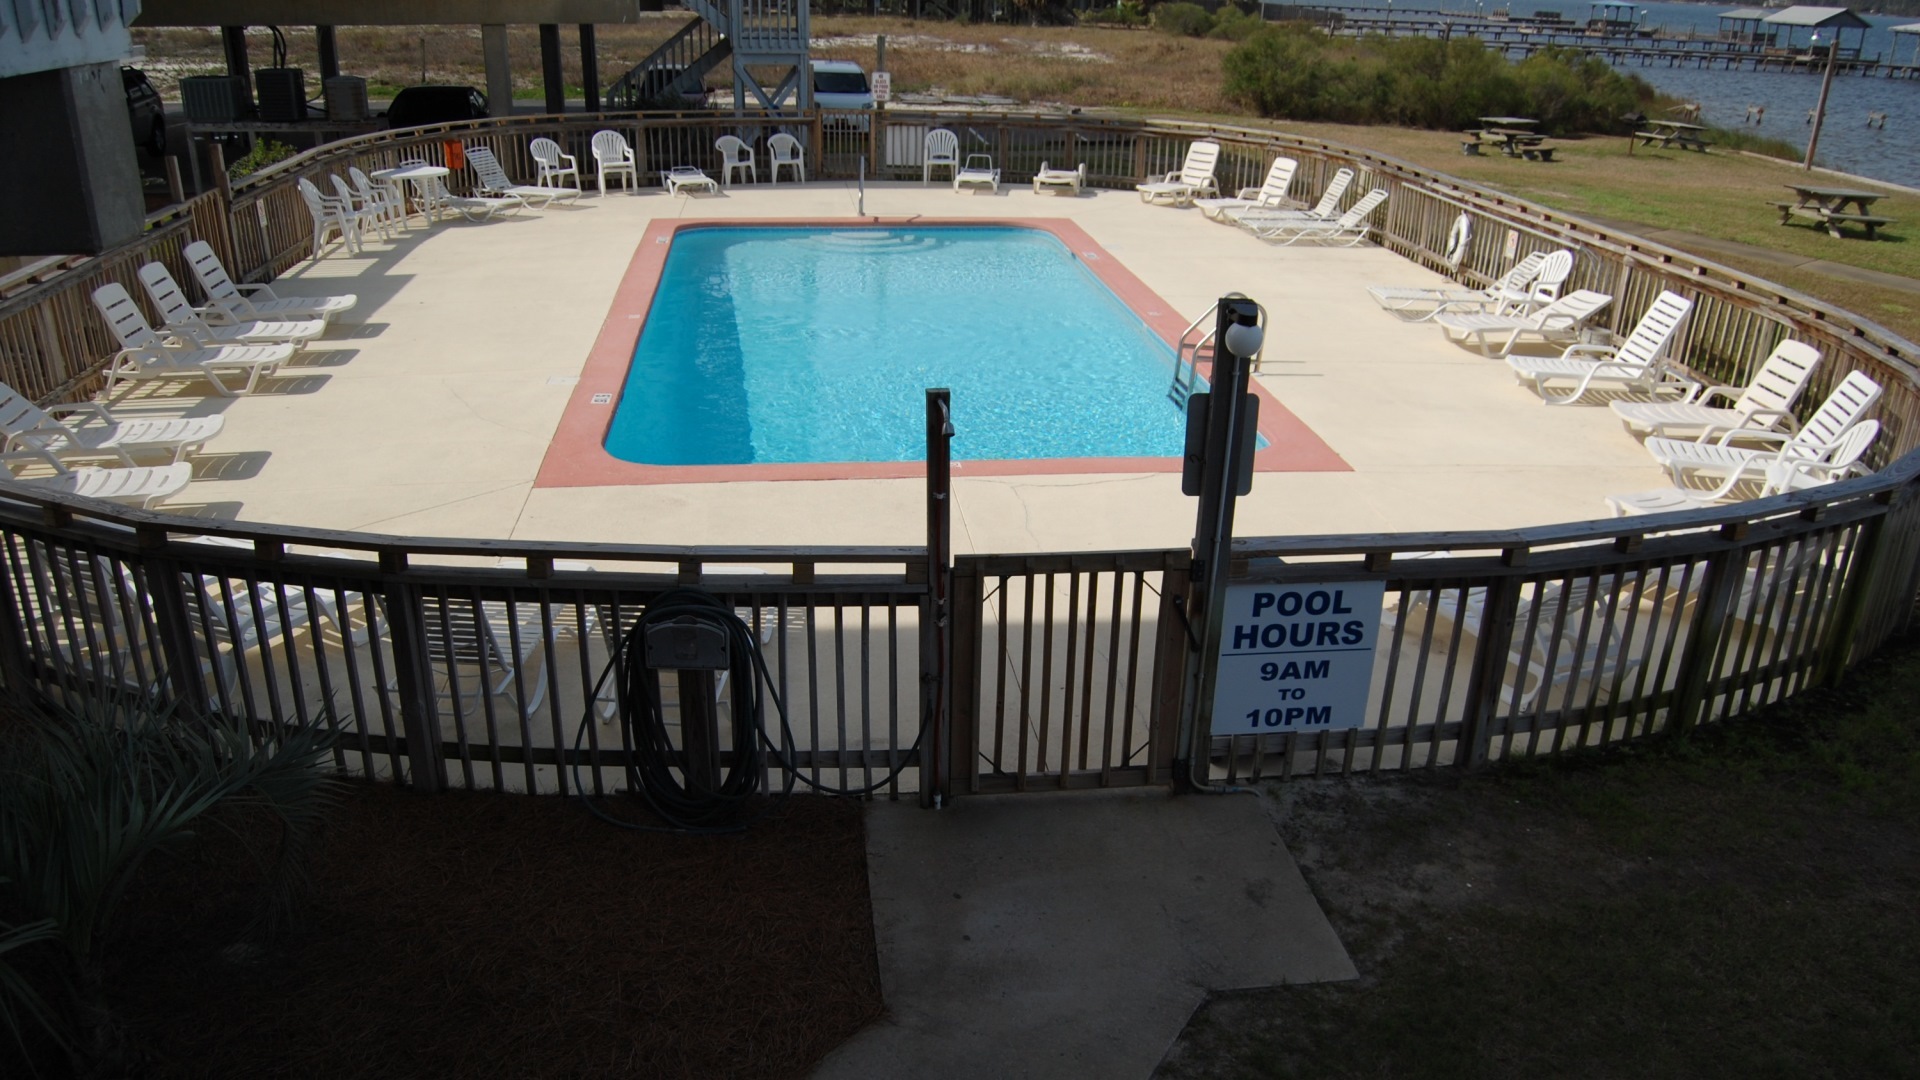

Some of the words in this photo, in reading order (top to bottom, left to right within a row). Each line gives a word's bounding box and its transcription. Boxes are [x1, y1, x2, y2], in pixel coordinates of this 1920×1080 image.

[1252, 590, 1352, 617] POOL
[1233, 620, 1364, 649] HOURS
[1260, 660, 1331, 681] 9AM
[1278, 688, 1306, 701] TO
[1246, 706, 1332, 728] 10PM
